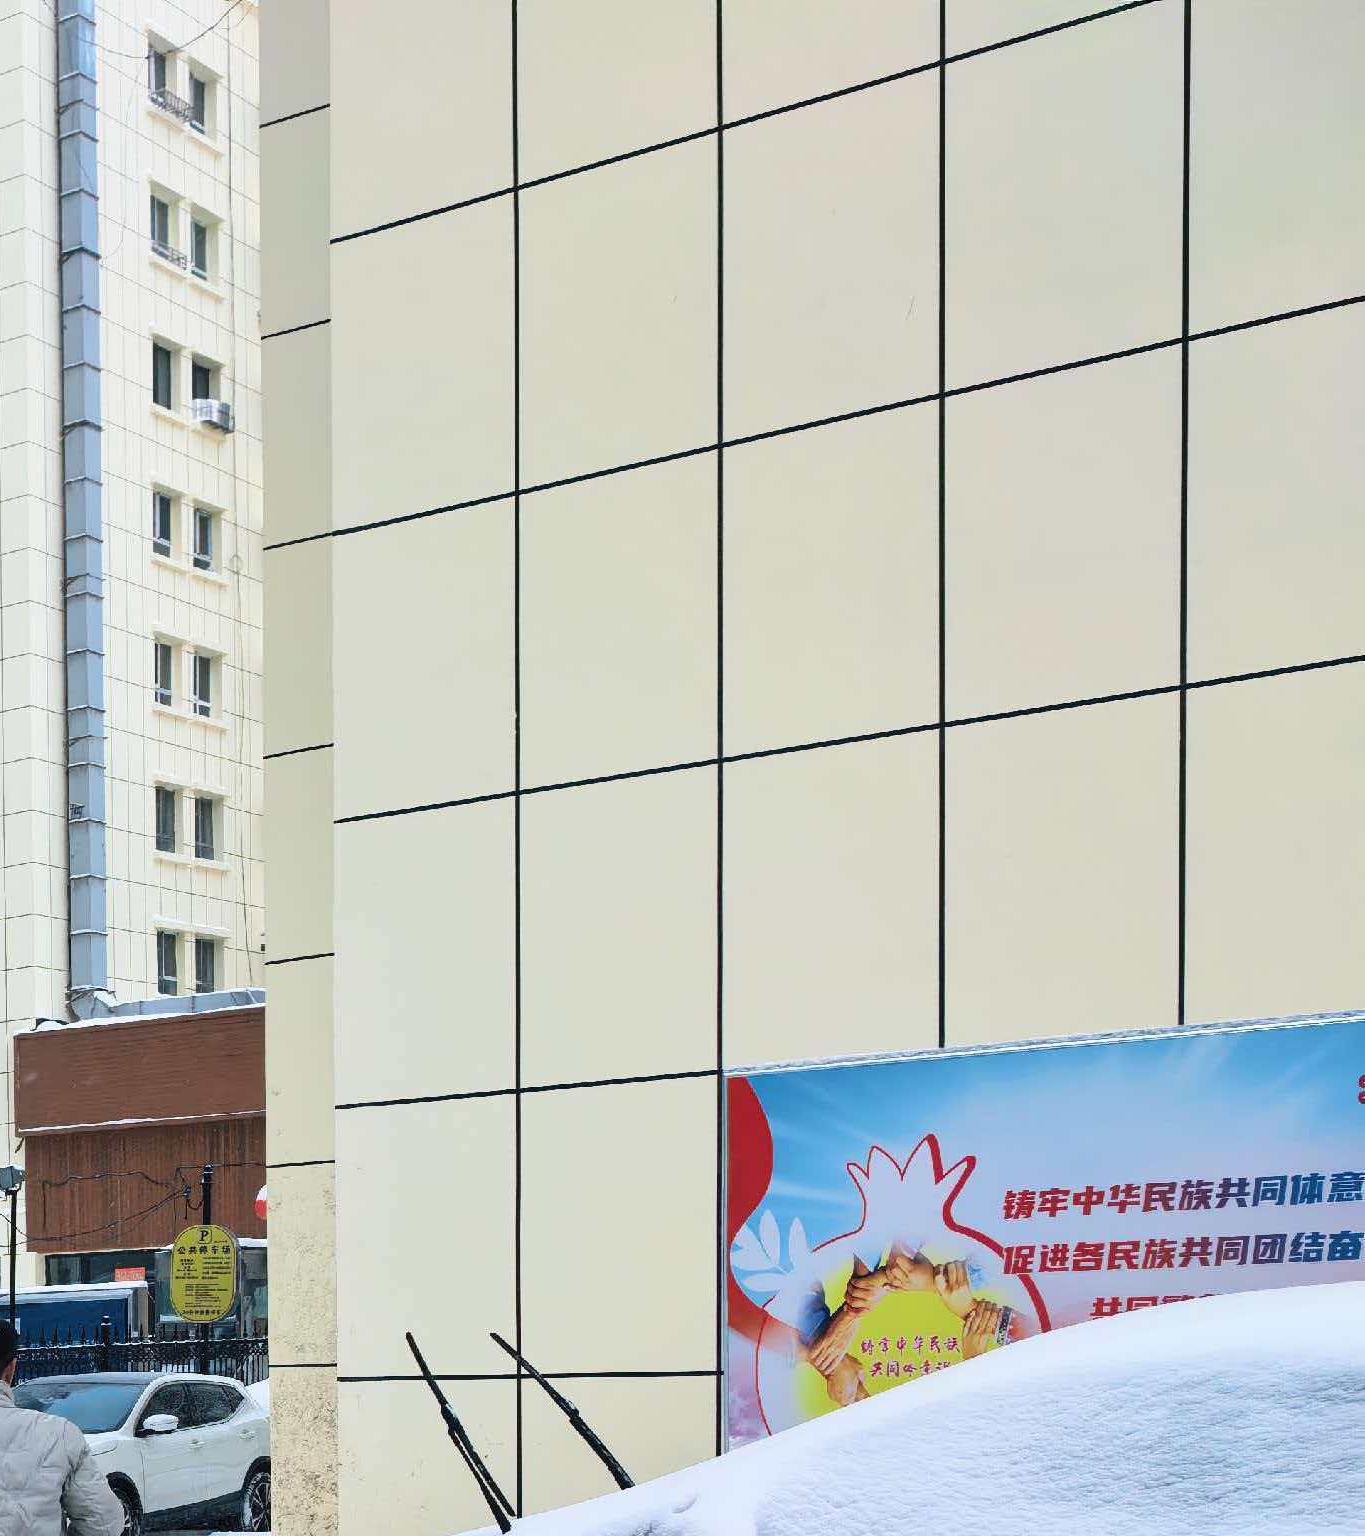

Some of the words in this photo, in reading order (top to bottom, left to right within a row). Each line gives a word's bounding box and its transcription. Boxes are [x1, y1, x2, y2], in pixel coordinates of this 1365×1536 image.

[1003, 1171, 1365, 1220] 铸牢中华民族共同体意
[1003, 1230, 1365, 1275] 促进各民族共同团结奋
